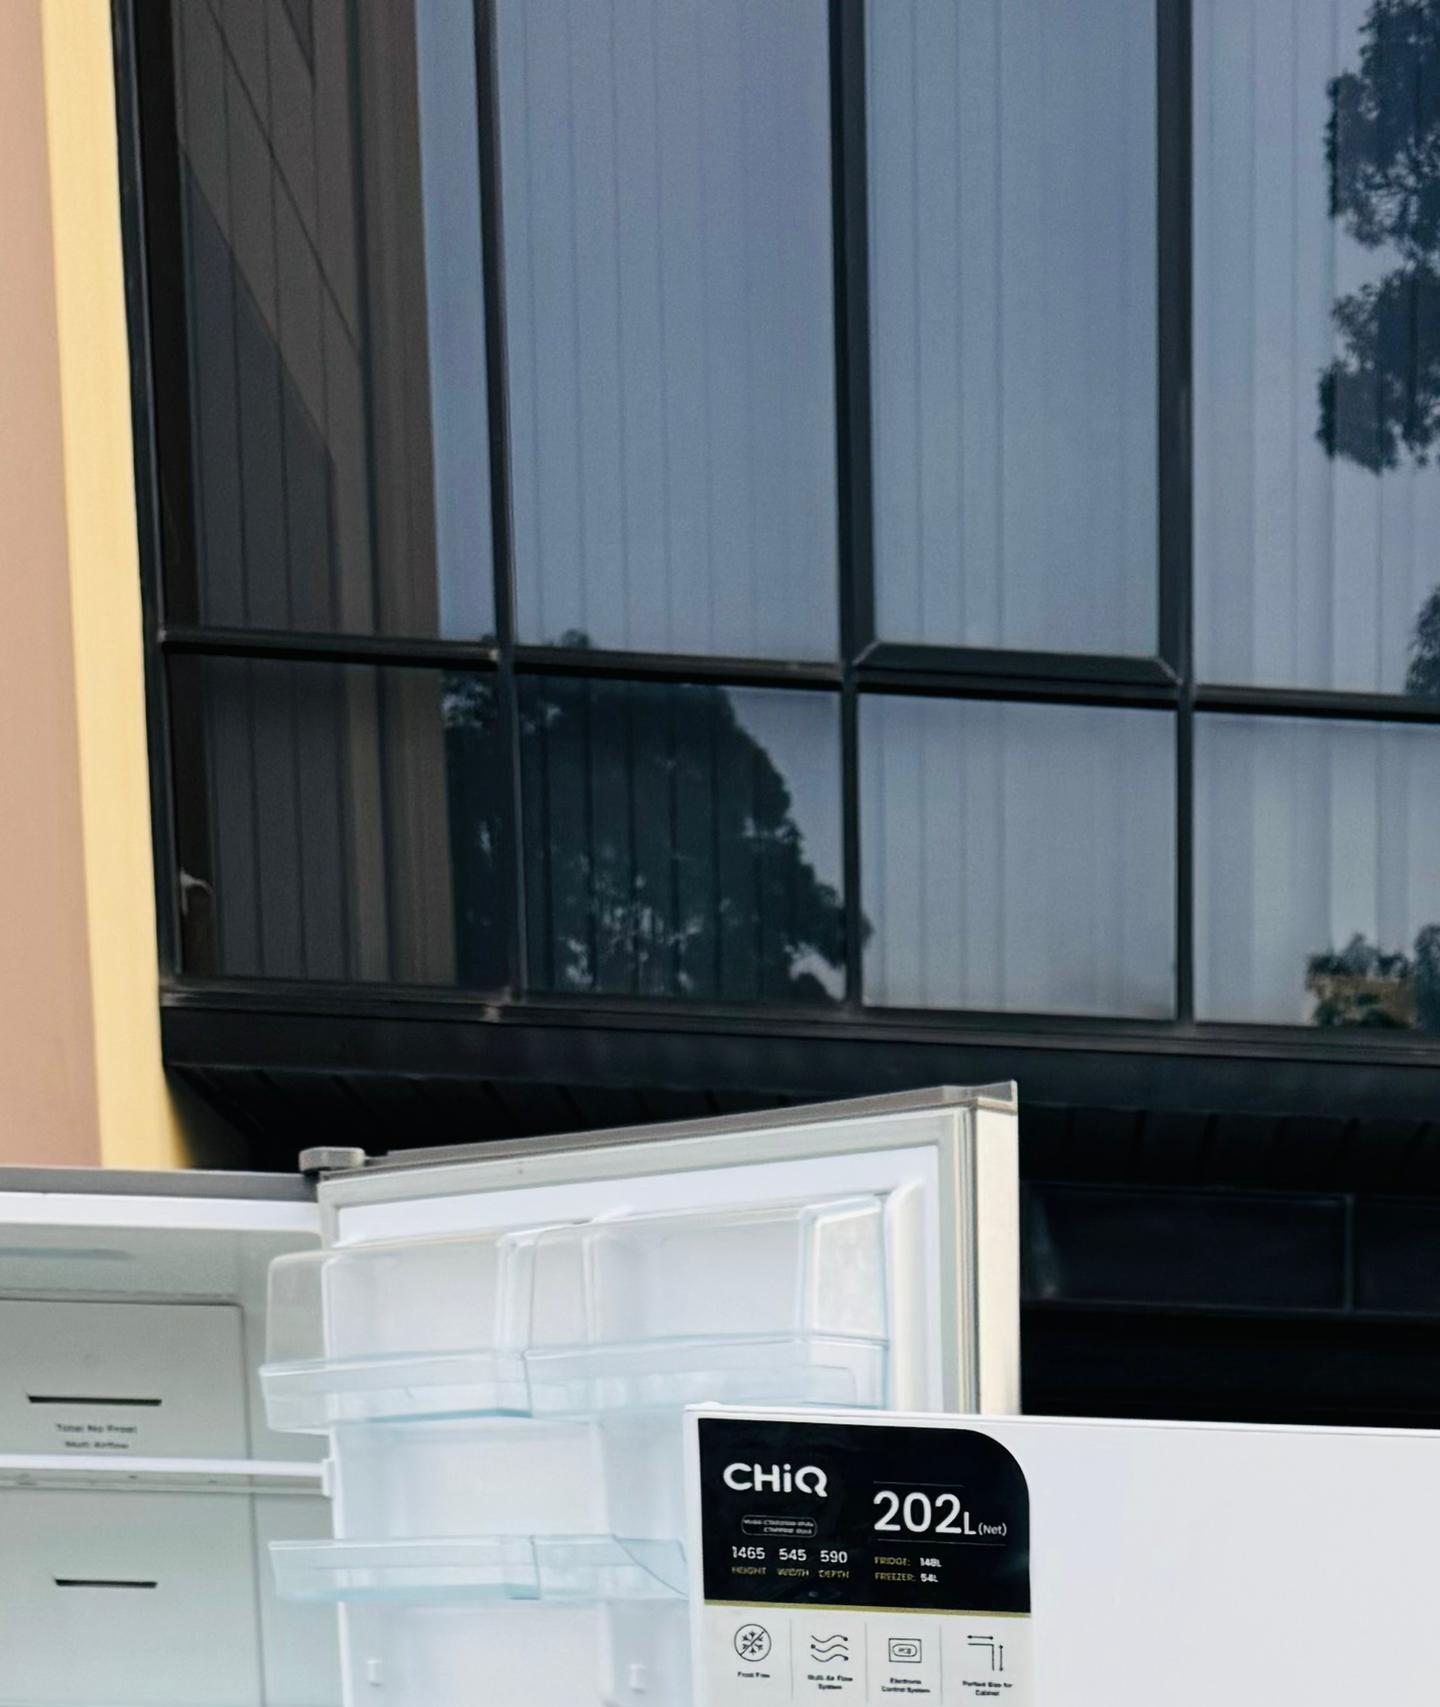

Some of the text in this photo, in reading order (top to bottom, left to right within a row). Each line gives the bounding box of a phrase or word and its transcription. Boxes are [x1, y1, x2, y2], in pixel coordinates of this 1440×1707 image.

[722, 1462, 828, 1497] CHiQ
[732, 1546, 848, 1563] 1465 545 590
[732, 1567, 849, 1578] HEIGHT WIDTH DEPTH
